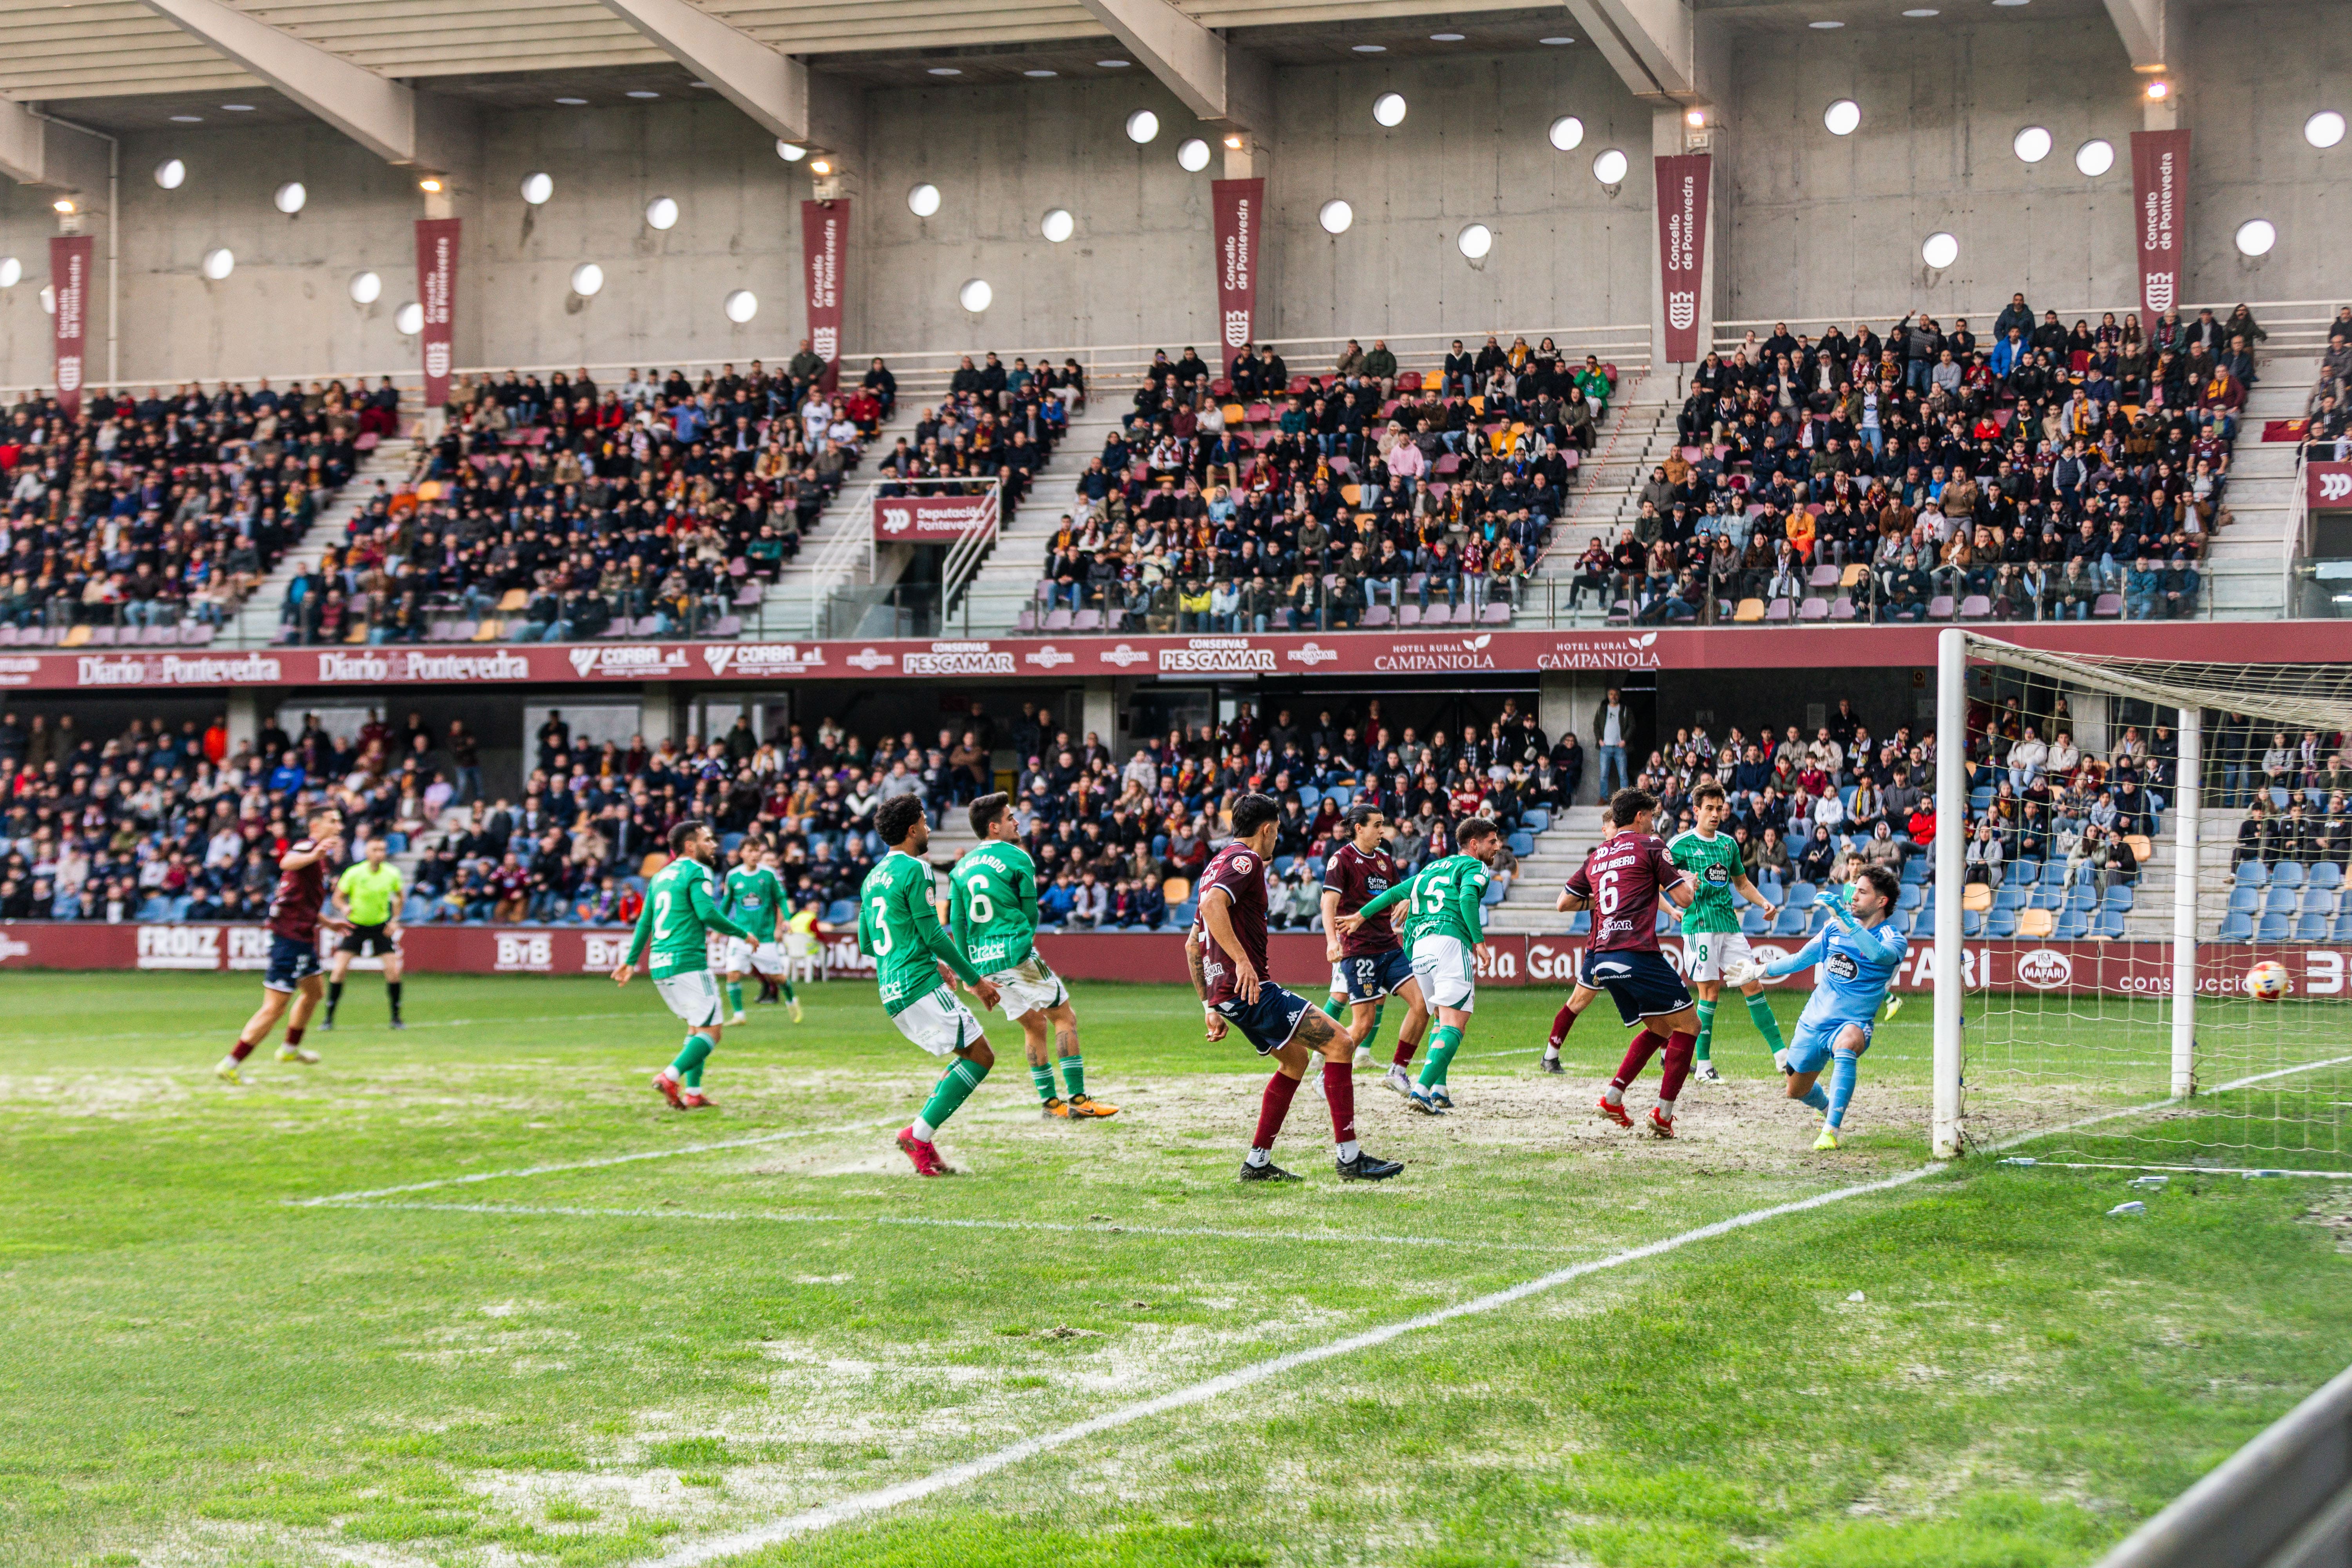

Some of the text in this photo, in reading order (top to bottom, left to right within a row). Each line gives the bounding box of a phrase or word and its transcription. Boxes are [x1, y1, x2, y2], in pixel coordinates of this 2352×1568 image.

[2160, 152, 2172, 250] de Pontevedra
[1682, 176, 1693, 270] de Pontevedra
[2145, 192, 2158, 250] Concello
[1236, 199, 1249, 290] de Pontevedra
[1669, 214, 1679, 270] Concello
[824, 219, 836, 307] de Pontevedra
[1225, 236, 1235, 290] Concello
[812, 255, 823, 308] Concello
[737, 645, 797, 663] CORBA
[931, 642, 990, 653] CONSERVAS
[1189, 639, 1249, 649] CONSERVAS
[1392, 644, 1463, 653] HOTEL RURAL
[1556, 641, 1628, 651] HOTEL RURAL
[318, 651, 388, 682] Diario
[407, 649, 529, 680] Pontevedra
[601, 647, 661, 665] CORBA
[903, 652, 1017, 674] PESCAMAR
[1159, 649, 1278, 671] PESCAMAR
[1287, 650, 1338, 661] PESCAMAR
[1374, 653, 1495, 670] CAMPANIOLA
[1537, 652, 1661, 669] CAMPANIOLA
[78, 655, 145, 685] Diario
[162, 652, 281, 684] Pontevedra
[1608, 856, 1635, 869] RIBEIRO
[866, 871, 893, 892] EDGAR
[1599, 870, 1618, 915] 6
[967, 875, 993, 923] 6
[1410, 874, 1450, 914] 15
[653, 891, 672, 940] 2
[871, 897, 893, 956] 3
[138, 926, 221, 957] FROIZ
[1527, 944, 1587, 980] Gal
[1699, 944, 1708, 962] 8
[1831, 957, 1853, 971] Estrella
[1356, 958, 1375, 977] 22
[1829, 964, 1851, 977] Galicia
[2025, 967, 2064, 978] MAFARI
